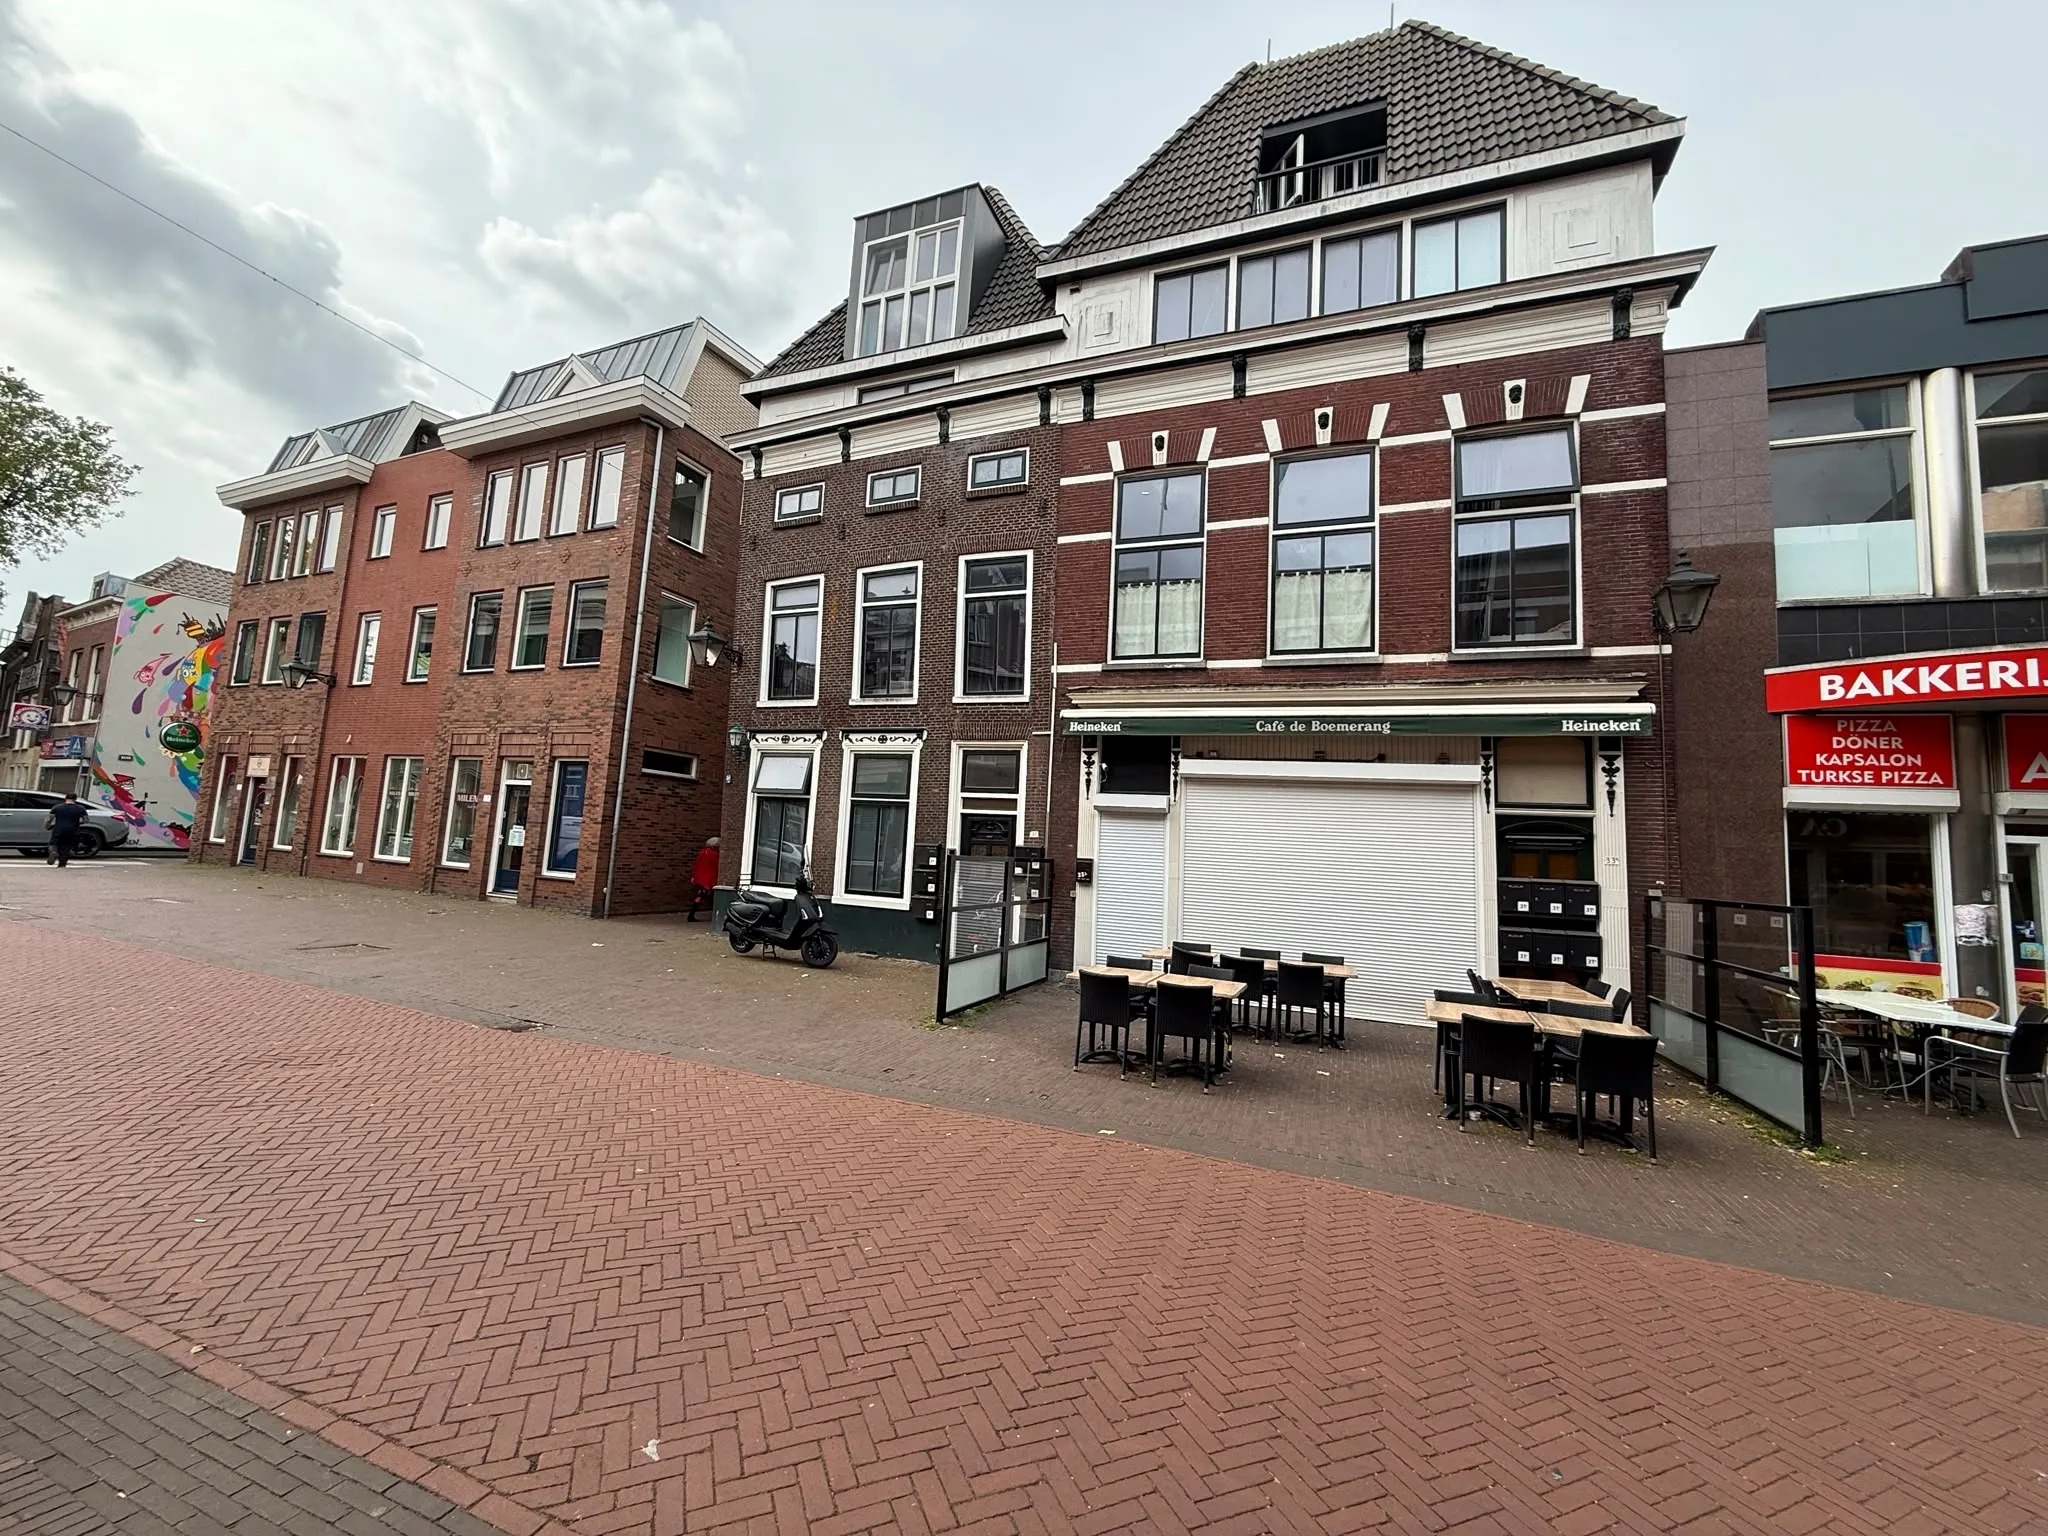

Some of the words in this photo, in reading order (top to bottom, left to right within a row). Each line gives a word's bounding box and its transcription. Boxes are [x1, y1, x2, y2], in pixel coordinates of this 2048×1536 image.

[1819, 658, 2048, 701] BAKKERI
[1069, 721, 1122, 732] Heineken
[1255, 720, 1286, 732] Café
[1289, 720, 1306, 732] de
[1311, 720, 1391, 735] Boemerang
[1561, 719, 1642, 732] Heineken
[1837, 719, 1897, 732] PIZZA
[1831, 734, 1904, 750] DÖNER
[1815, 753, 1922, 767] KAPSALON
[1796, 769, 1875, 784] TURKSE
[1881, 771, 1944, 785] PIZZA
